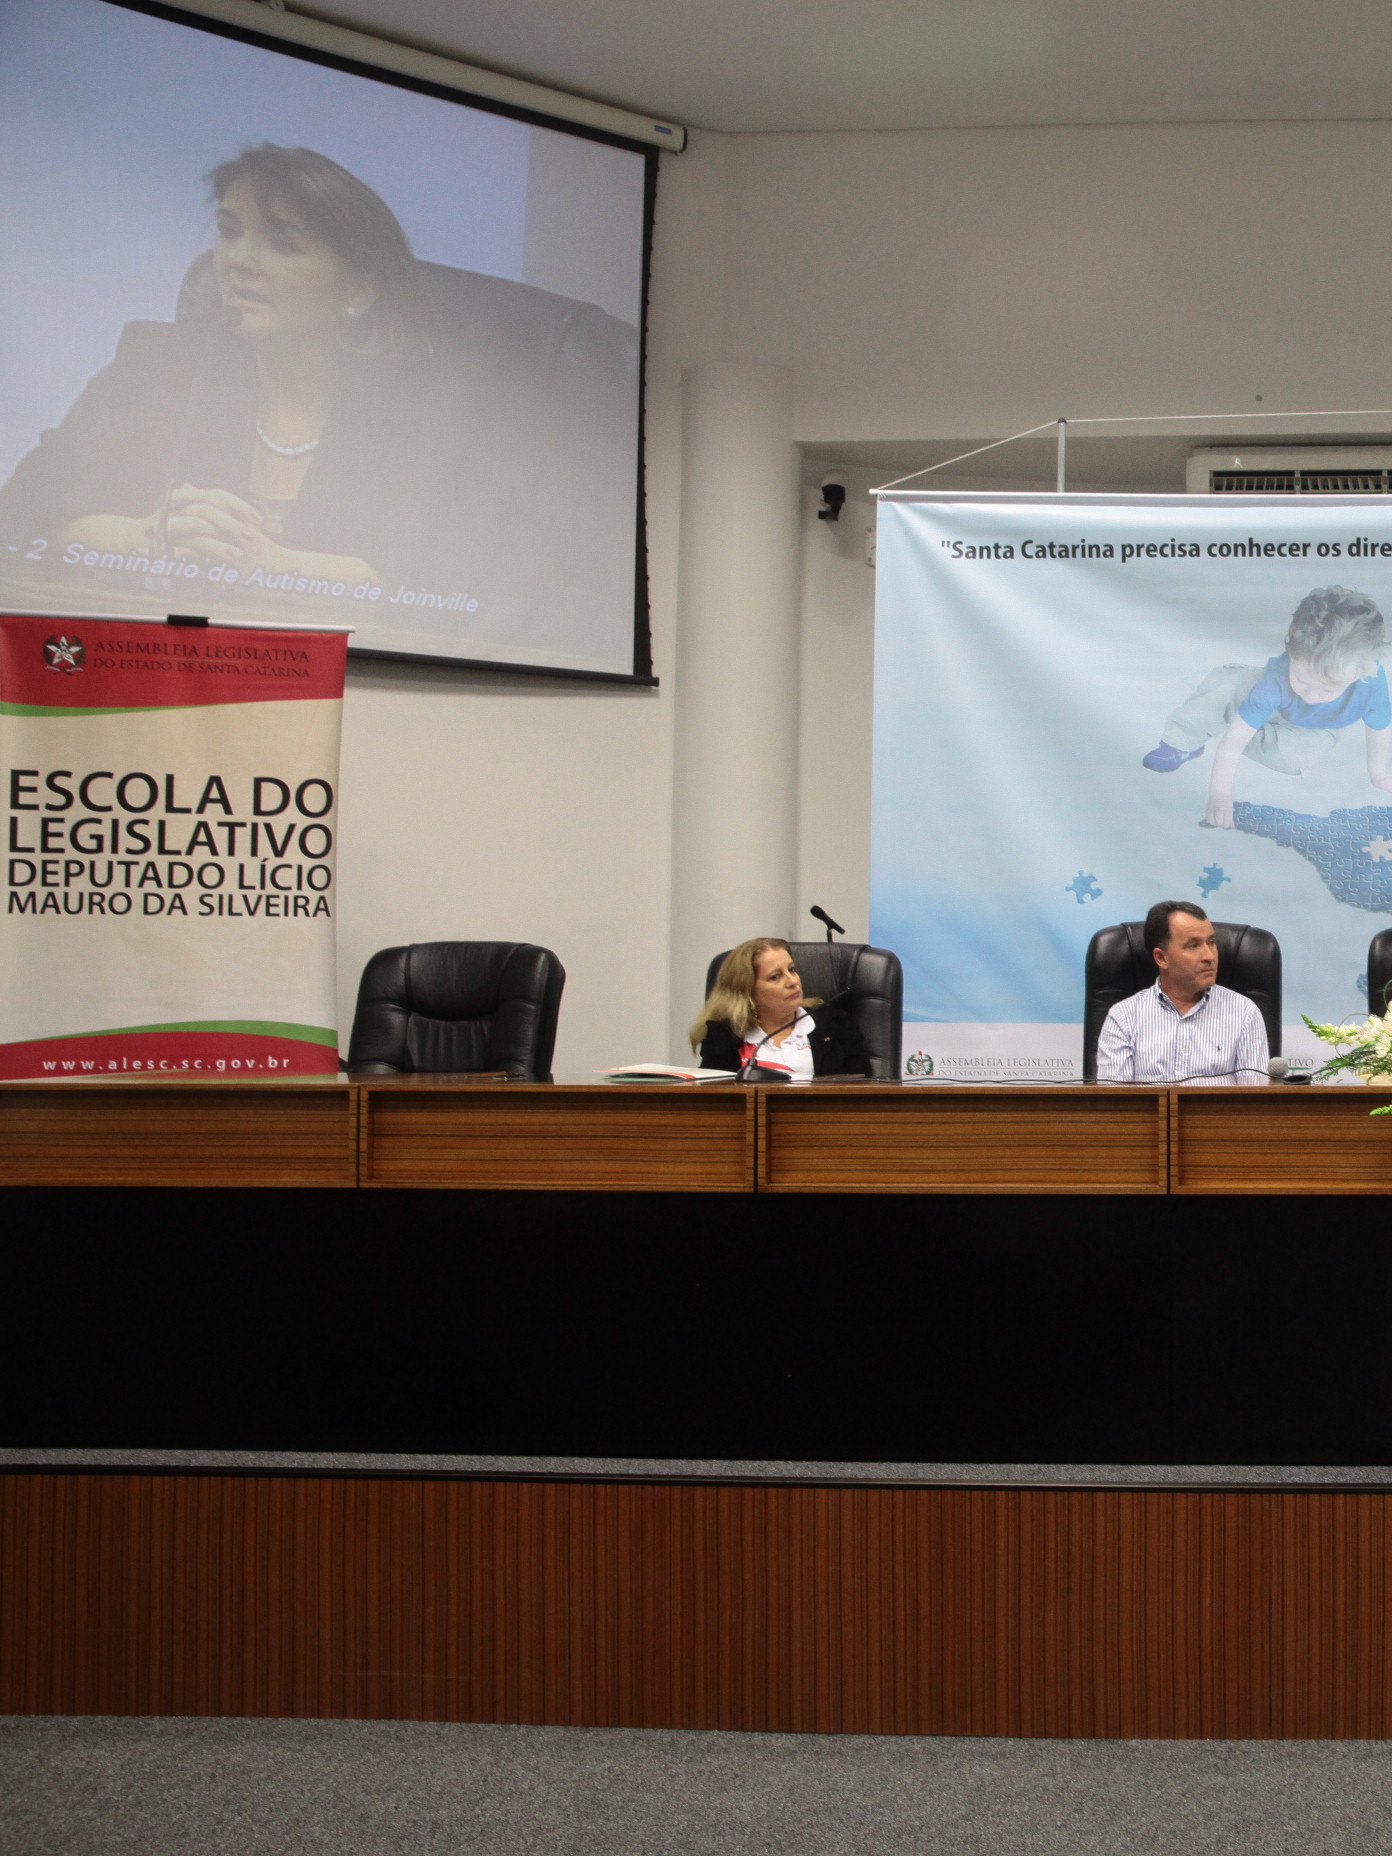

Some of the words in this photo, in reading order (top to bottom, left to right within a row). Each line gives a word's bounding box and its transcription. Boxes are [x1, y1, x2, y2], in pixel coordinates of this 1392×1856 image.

[940, 539, 1015, 560] "Santa
[1021, 538, 1115, 560] Catarina
[1121, 537, 1201, 563] precisa
[1207, 537, 1311, 558] conhecer
[1316, 540, 1342, 558] os
[26, 538, 48, 560] 2
[62, 543, 200, 579] Seminário
[207, 562, 239, 584] de
[245, 567, 346, 597] Autismo
[353, 580, 382, 601] de
[389, 585, 479, 613] Joinville
[94, 640, 200, 658] ASSEMBLEIA
[205, 642, 310, 662] LEGISLATIVA
[94, 658, 116, 670] DO
[120, 659, 173, 672] ESTADO
[177, 662, 194, 673] DE
[199, 663, 241, 675] SANTA
[244, 665, 311, 678] CATARINA
[10, 768, 234, 816] ESCOLA
[252, 776, 334, 819] DO
[9, 815, 334, 860] LEGISLATIVO
[7, 858, 226, 890] DEPUTADO
[238, 857, 333, 892] LÍCIO
[7, 890, 133, 916] MAURO
[143, 892, 189, 916] DA
[198, 893, 332, 918] SILVEIRA
[42, 1056, 291, 1073] www.alesc.sc.gov.br
[939, 1057, 1004, 1067] ASSEMBLEIA
[1007, 1057, 1074, 1068] LEGISLATIVA
